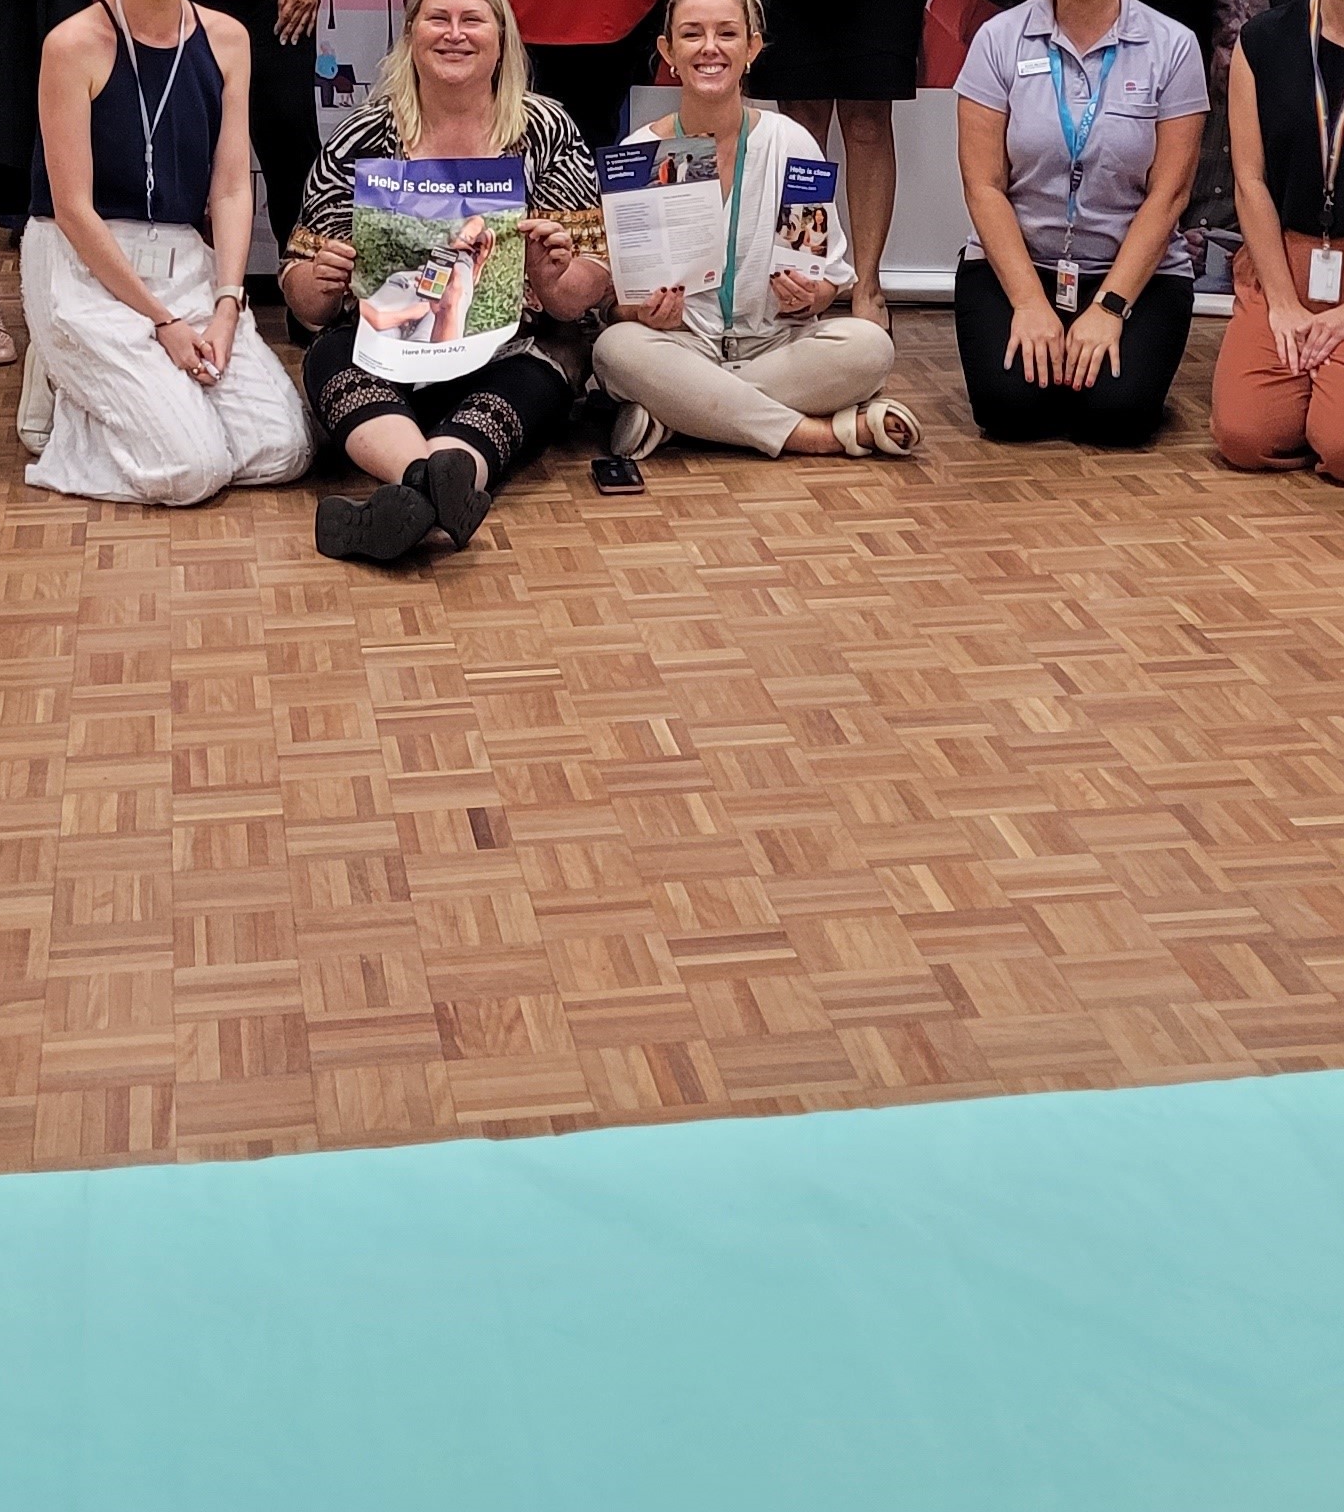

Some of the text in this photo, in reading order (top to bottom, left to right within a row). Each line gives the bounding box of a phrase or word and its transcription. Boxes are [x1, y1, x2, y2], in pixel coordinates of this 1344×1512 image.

[368, 174, 513, 194] Help is close at hand
